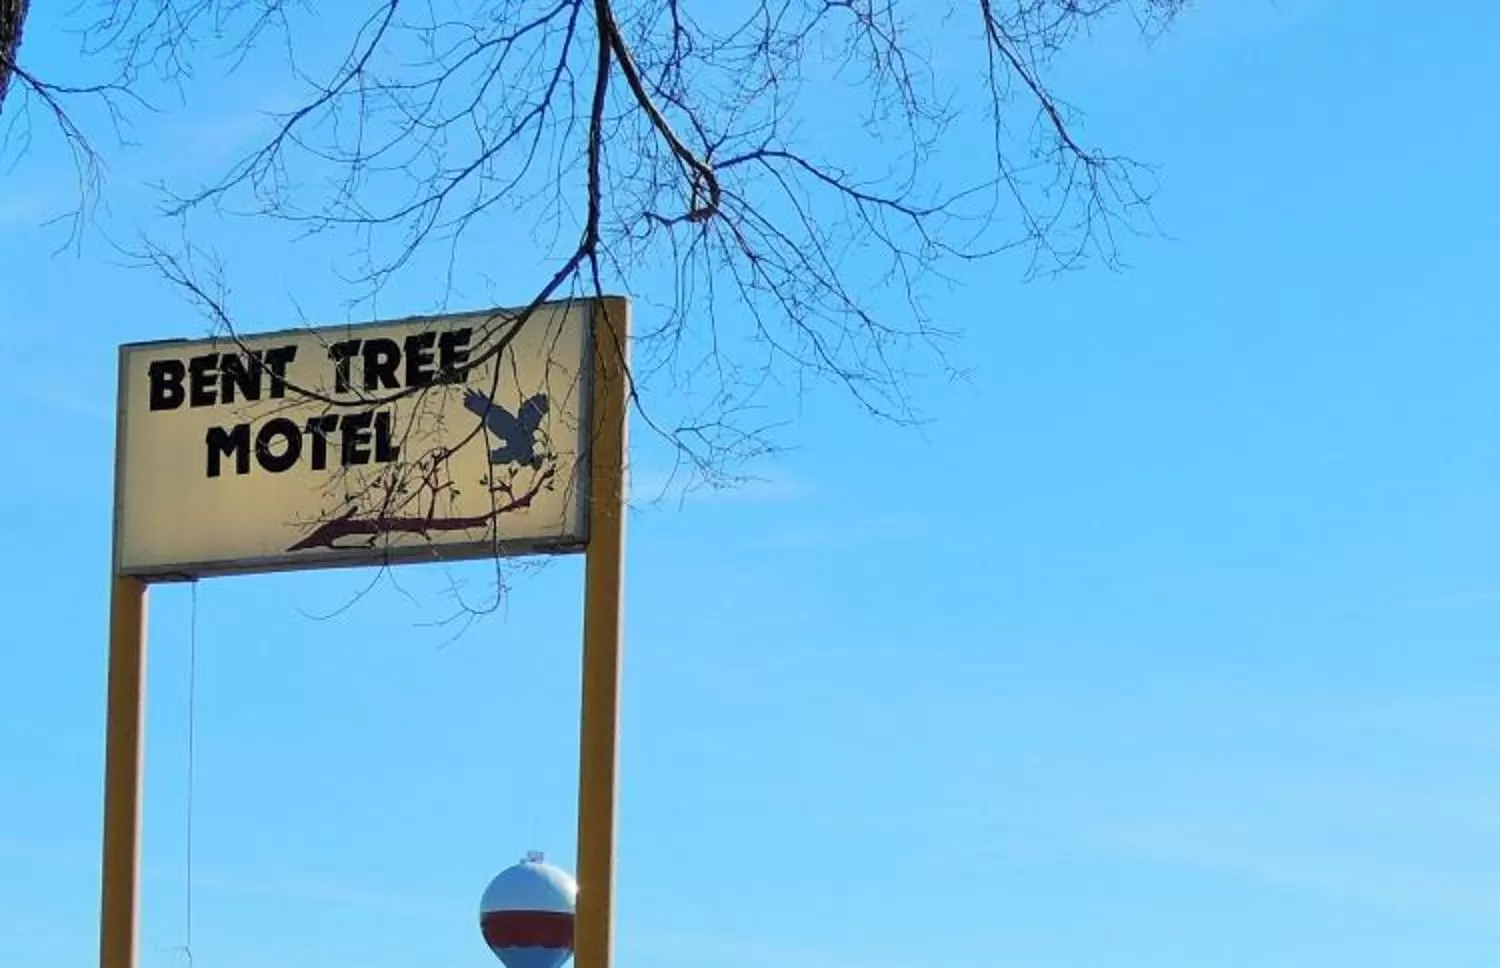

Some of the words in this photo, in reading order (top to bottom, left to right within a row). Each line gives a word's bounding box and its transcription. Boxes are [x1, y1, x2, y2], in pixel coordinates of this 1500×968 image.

[148, 345, 298, 412] BENT
[329, 328, 473, 395] TREE
[206, 411, 400, 478] MOTEL
